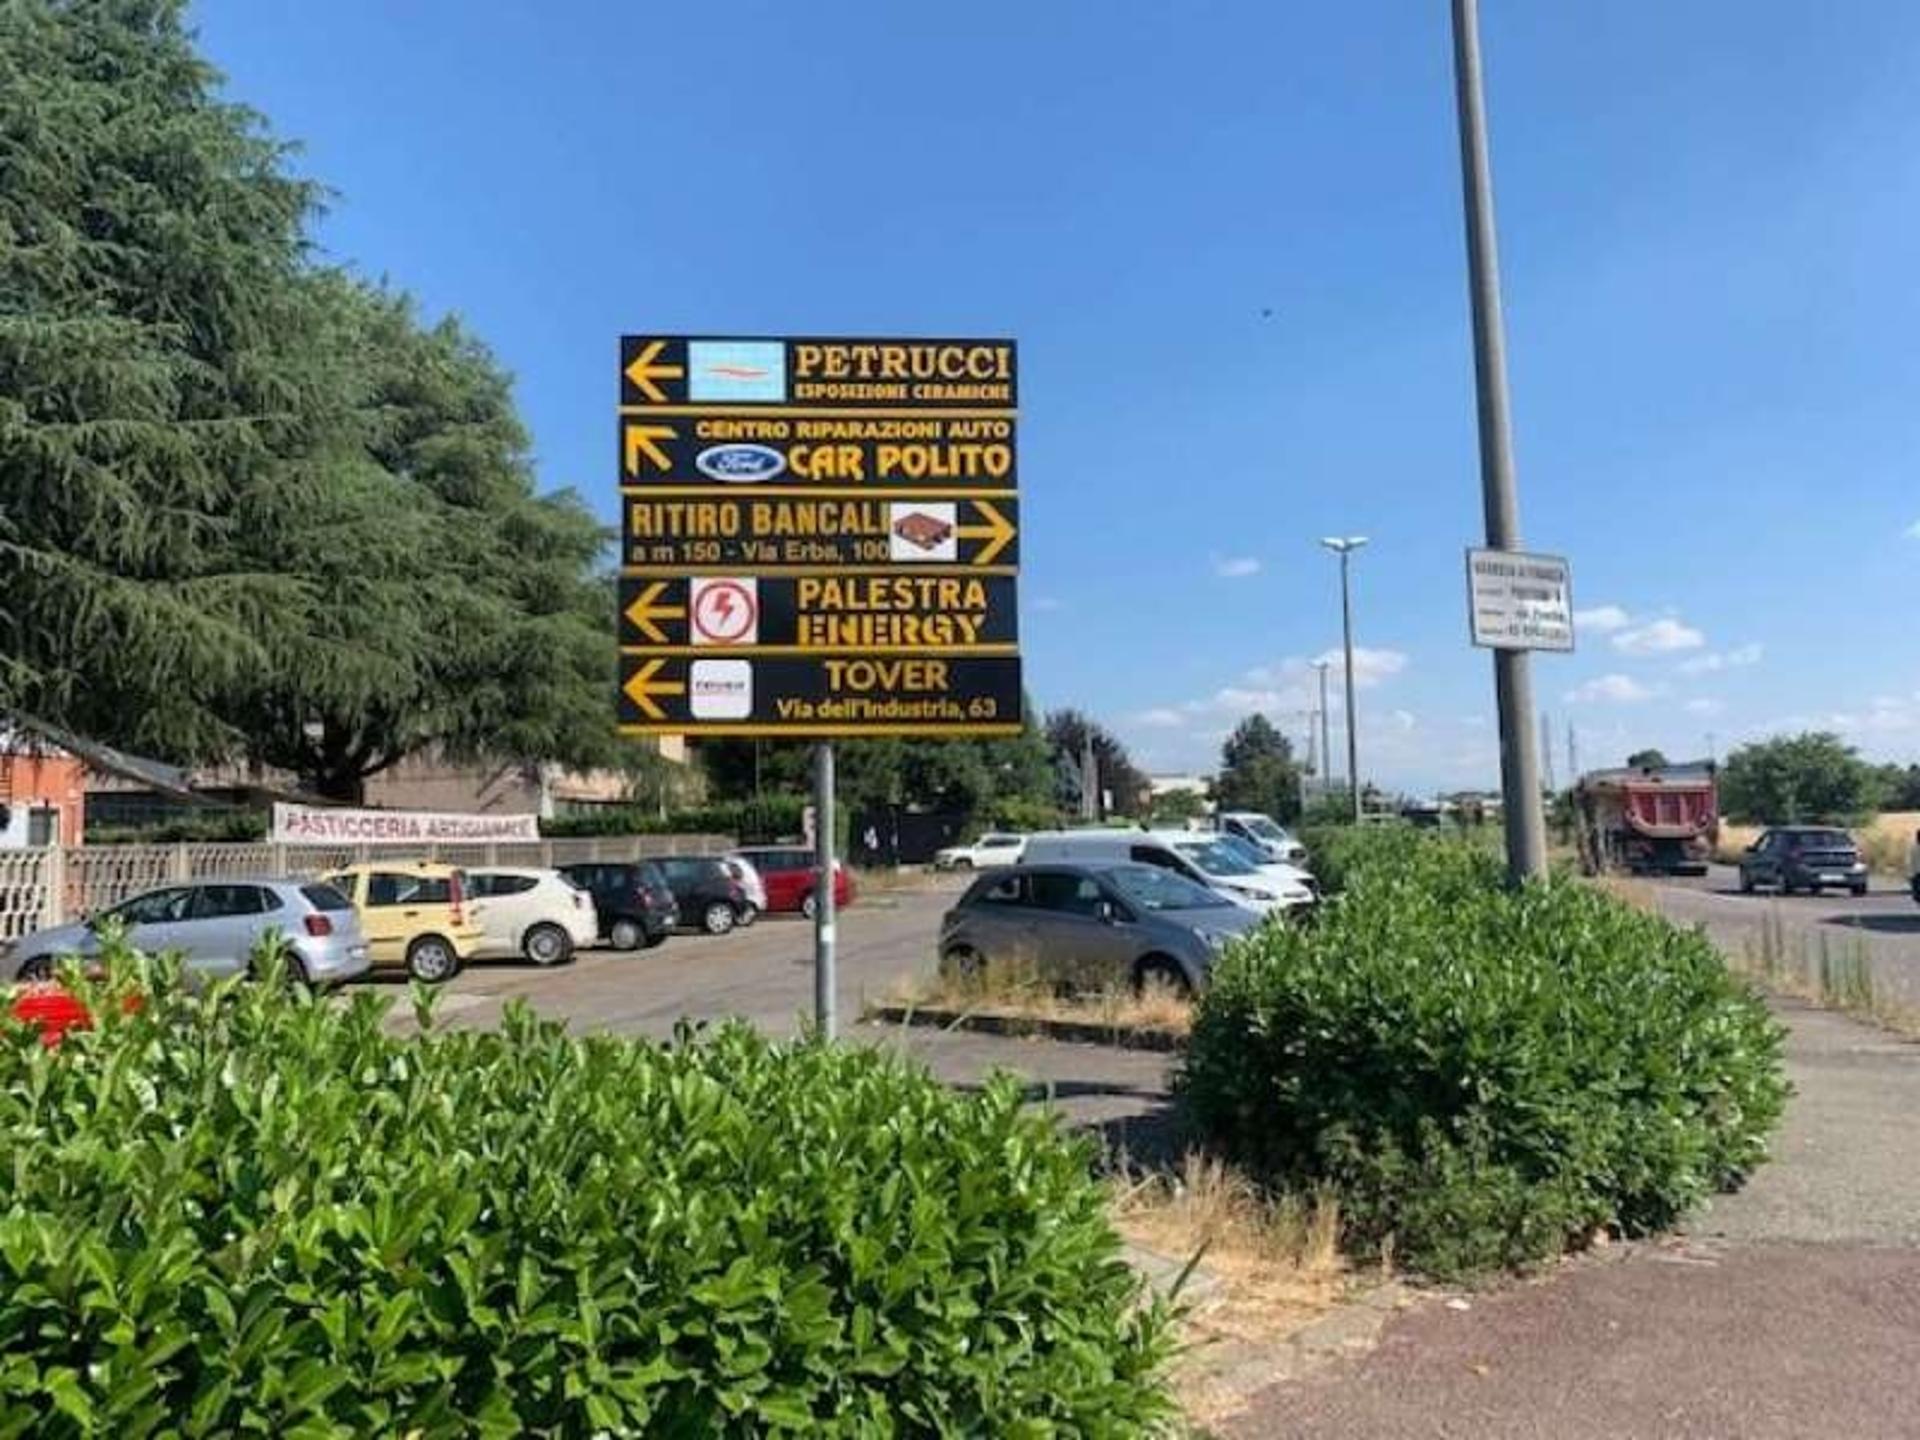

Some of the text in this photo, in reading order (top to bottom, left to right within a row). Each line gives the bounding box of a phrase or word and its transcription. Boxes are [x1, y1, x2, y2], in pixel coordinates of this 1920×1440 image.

[795, 345, 1010, 378] PETRUCCI
[912, 384, 1009, 399] CERAMICHE
[696, 421, 1009, 438] CENTRO RIPARAZIONI AUTO
[789, 445, 1011, 480] CAR POLITO
[632, 503, 889, 537] RITIRO BANCALI
[633, 546, 645, 561] a
[652, 547, 673, 561] m
[682, 542, 720, 561] 150
[741, 541, 777, 560] Via
[854, 540, 888, 560] 100
[799, 578, 986, 610] PALESTRA
[798, 613, 985, 644] ENERGY
[825, 660, 948, 691] TOVER
[777, 699, 814, 718] Via
[969, 699, 997, 718] 63
[286, 812, 421, 837] PASTICCERIA
